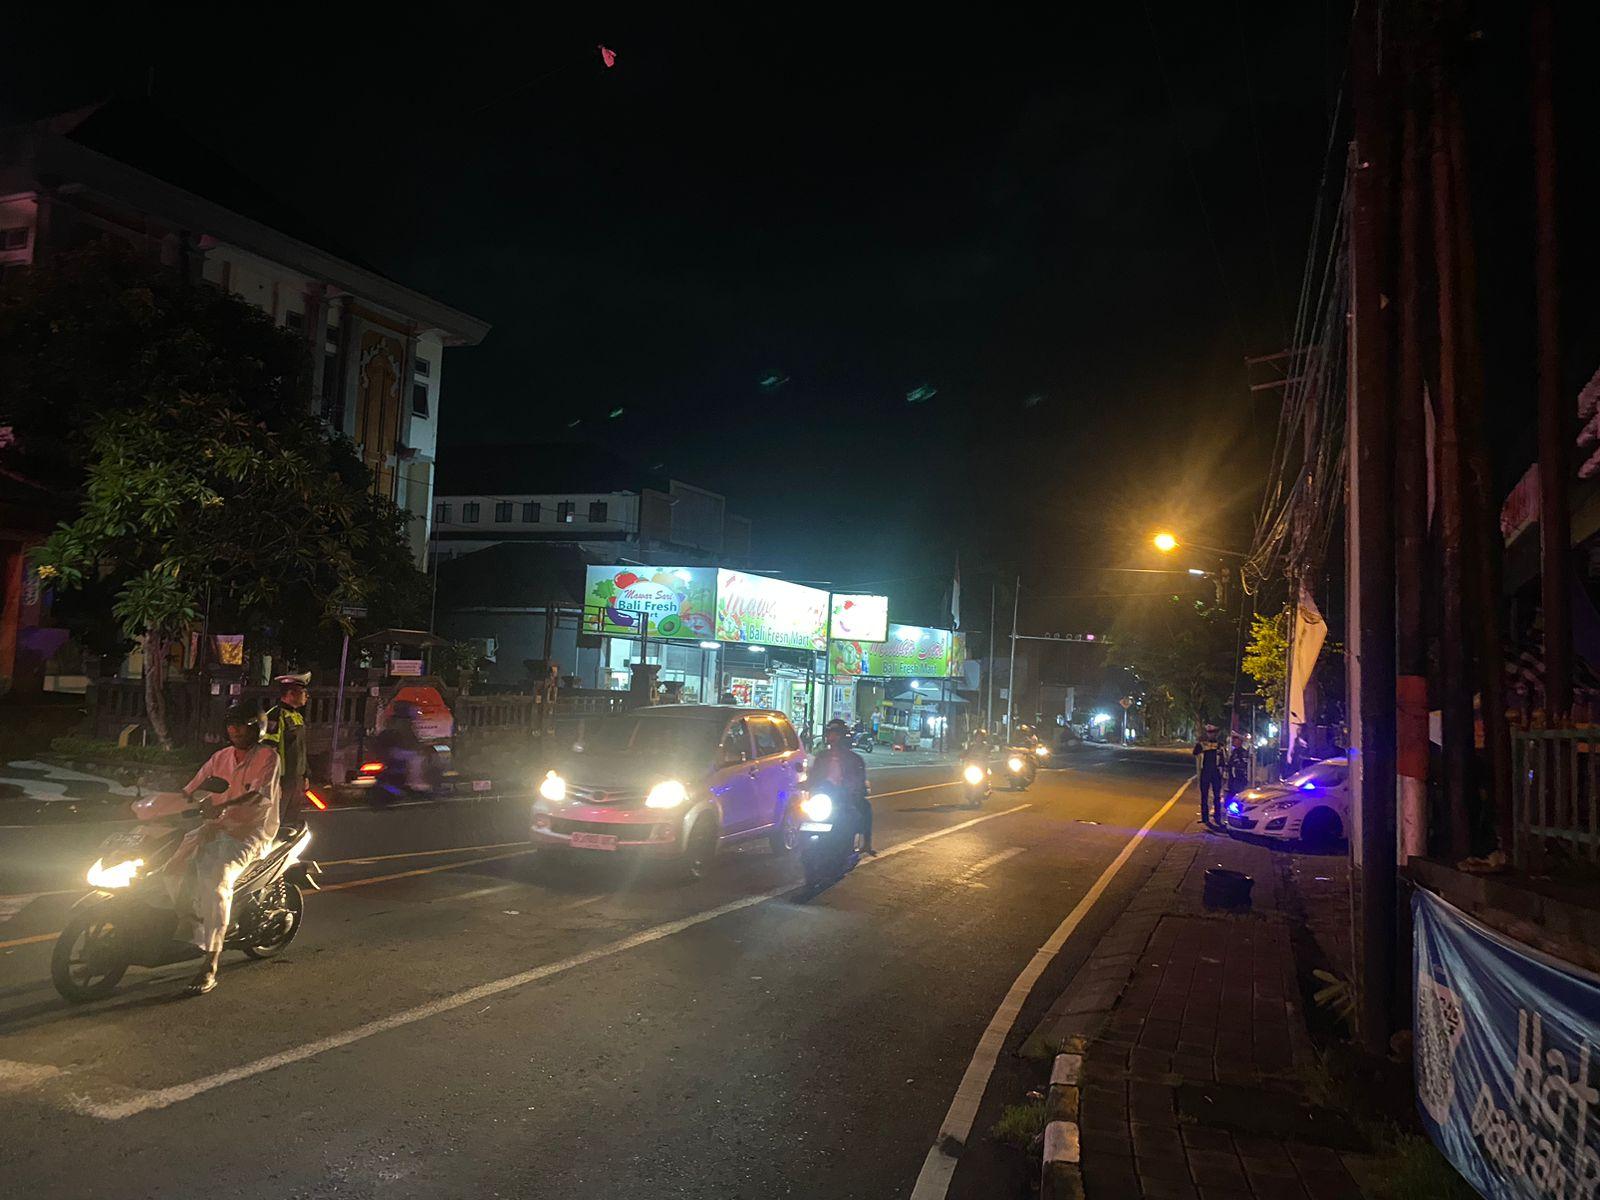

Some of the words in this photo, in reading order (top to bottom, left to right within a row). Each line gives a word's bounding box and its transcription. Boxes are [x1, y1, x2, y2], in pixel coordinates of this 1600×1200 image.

[625, 590, 653, 600] Mawar
[655, 590, 675, 600] Sari
[618, 600, 641, 611] Bali
[644, 601, 678, 612] Fresh
[749, 624, 766, 641] Bali
[791, 631, 809, 646] Mart
[882, 662, 897, 673] Bali
[900, 663, 918, 674] Fresh
[920, 662, 937, 674] Mart
